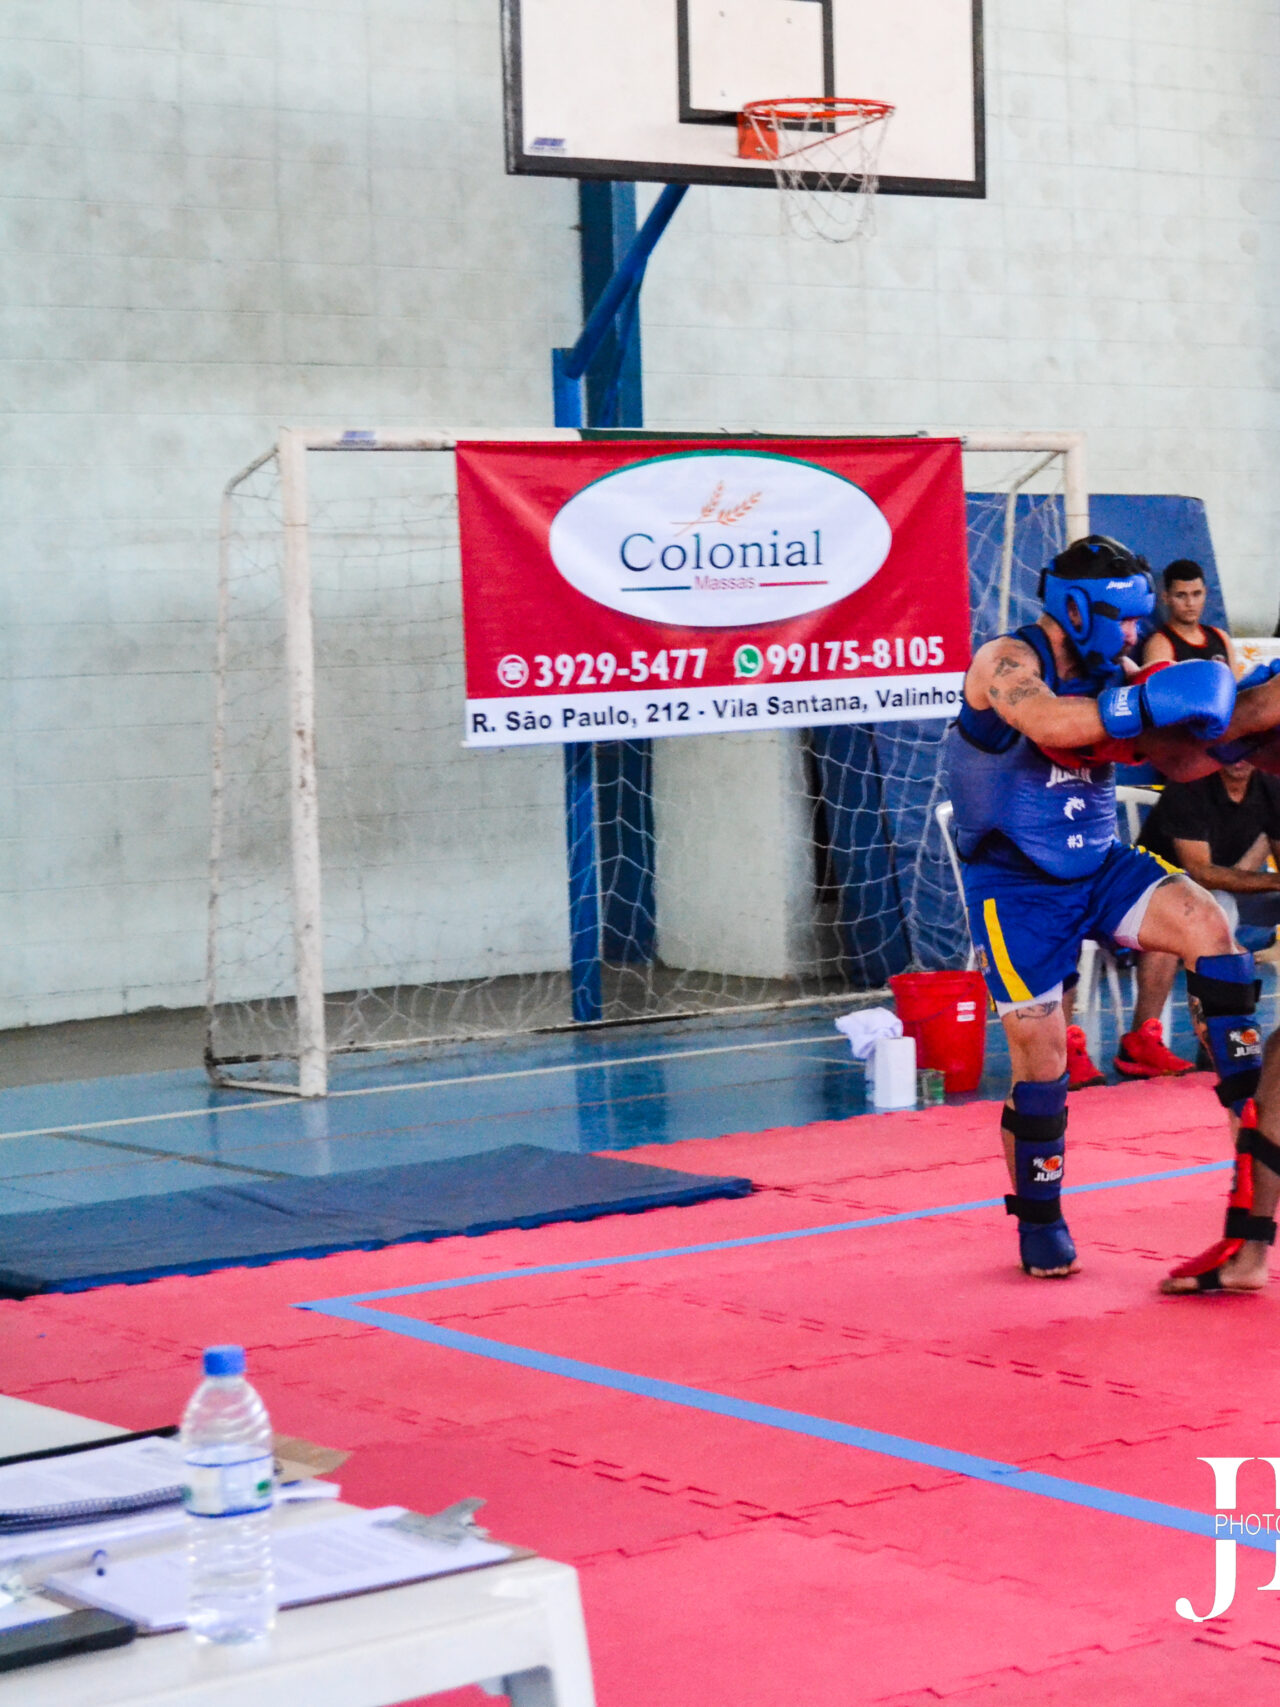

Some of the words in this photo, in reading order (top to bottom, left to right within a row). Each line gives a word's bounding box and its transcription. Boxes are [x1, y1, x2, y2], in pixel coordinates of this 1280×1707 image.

[619, 529, 824, 572] Colonial
[694, 575, 756, 591] Massas
[533, 647, 708, 688] 3929-5477
[766, 636, 945, 676] 99175-8105
[472, 713, 496, 733] R.
[506, 710, 551, 732] São
[563, 706, 637, 728] Paulo,
[646, 702, 690, 723] 212
[713, 698, 758, 719] Vila
[767, 695, 868, 715] Santana,
[1067, 834, 1084, 848] #3
